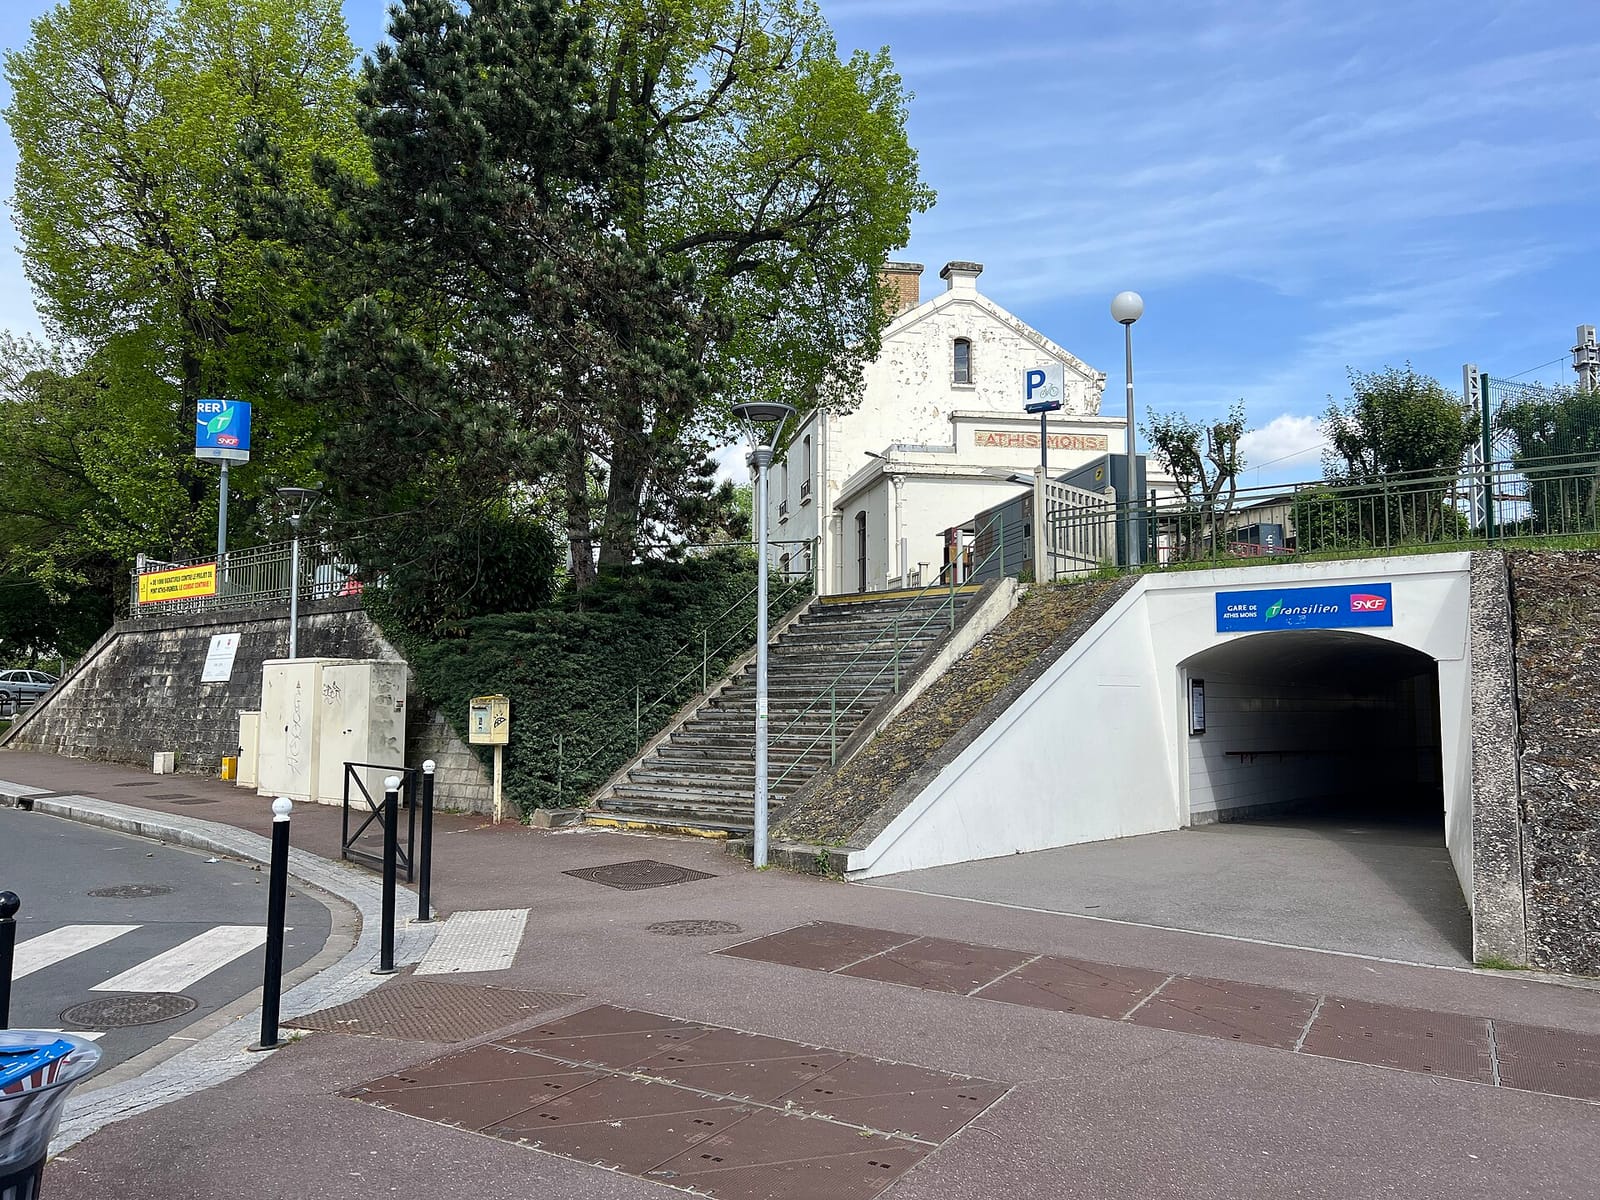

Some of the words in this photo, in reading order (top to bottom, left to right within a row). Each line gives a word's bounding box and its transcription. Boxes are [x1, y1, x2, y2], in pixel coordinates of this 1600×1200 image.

[1026, 369, 1046, 400] P
[197, 402, 221, 413] RER
[1271, 604, 1339, 615] Transilien
[1352, 600, 1383, 610] SNCF
